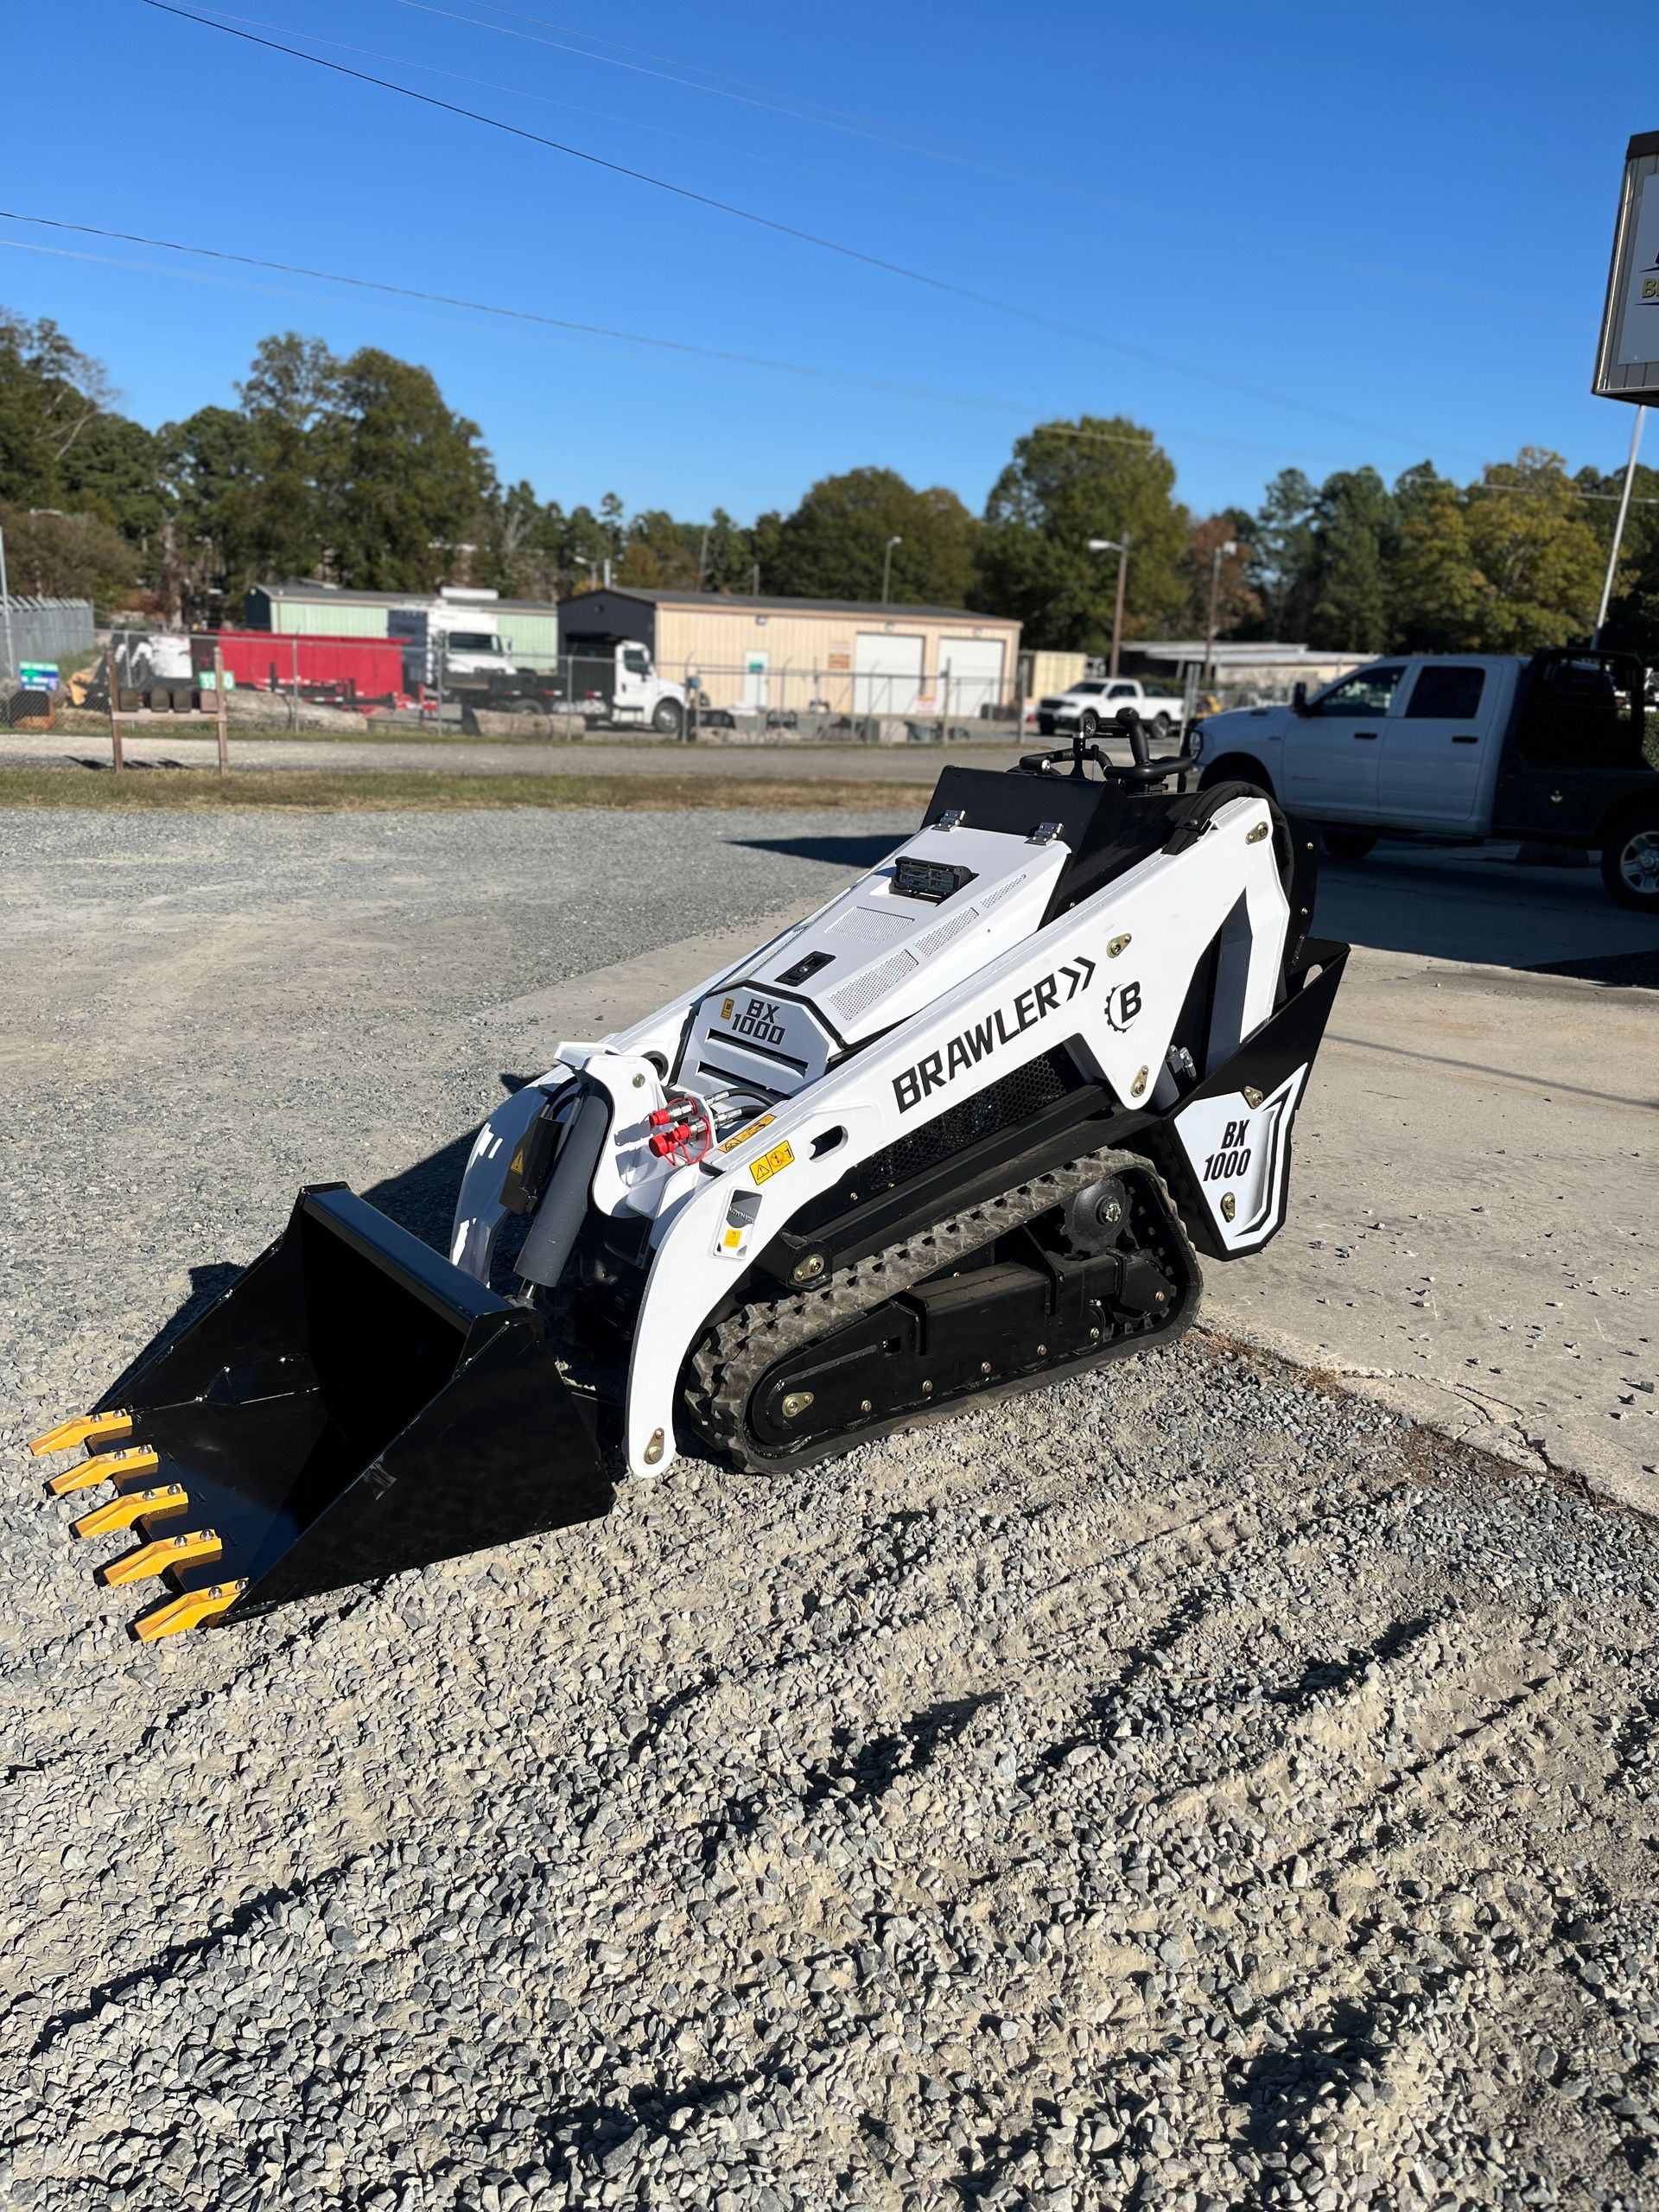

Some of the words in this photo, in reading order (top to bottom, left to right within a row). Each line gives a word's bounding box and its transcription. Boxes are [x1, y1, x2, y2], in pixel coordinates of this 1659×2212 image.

[1643, 278, 1659, 298] B
[747, 999, 780, 1024] BX
[1120, 981, 1141, 1024] B
[732, 1014, 785, 1046] 1000
[892, 973, 1061, 1114] BRAWLER
[1221, 1119, 1250, 1149] BX
[1203, 1148, 1251, 1182] 1000
